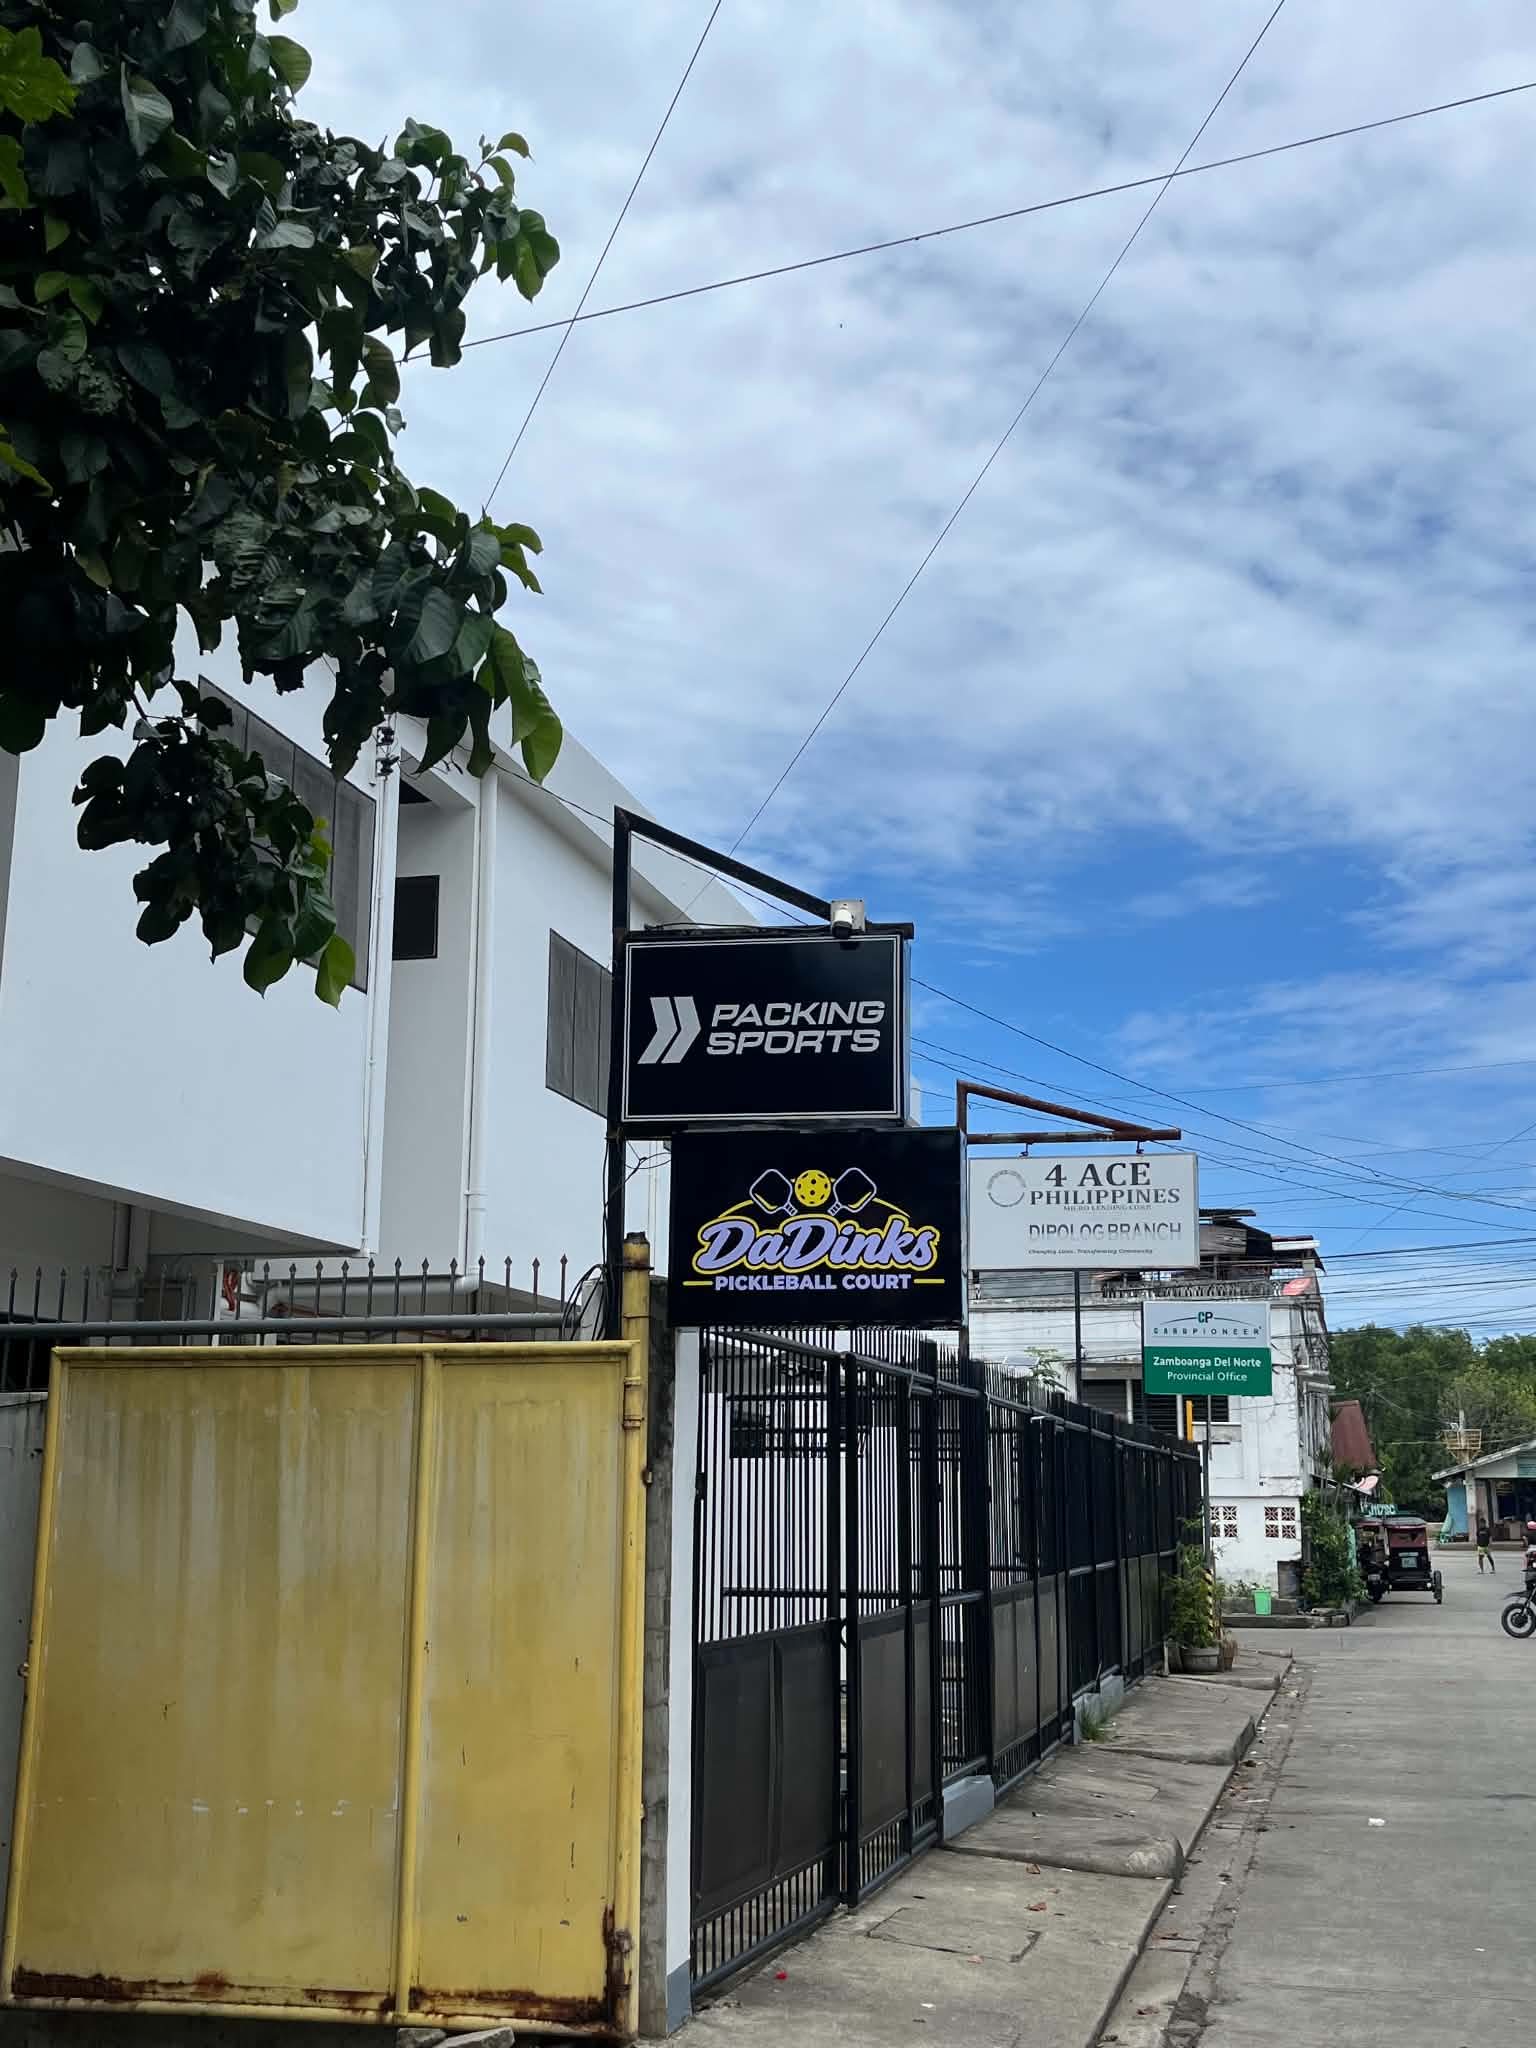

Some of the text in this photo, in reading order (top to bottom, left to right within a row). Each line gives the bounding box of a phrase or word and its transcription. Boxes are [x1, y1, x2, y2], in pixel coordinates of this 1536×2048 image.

[711, 1000, 886, 1027] PACKING
[706, 1028, 881, 1055] SPORTS
[1044, 1163, 1067, 1187] 4
[1077, 1161, 1151, 1187] ACE
[1029, 1187, 1181, 1206] PHILIPPINES
[1029, 1221, 1182, 1241] DIPOLOG BRANCH
[695, 1216, 938, 1272] DaDinks
[714, 1273, 912, 1291] PICKLEBALL COURT
[1197, 1311, 1214, 1323] CP
[1153, 1356, 1262, 1369] Zamboanga Del Norte
[1167, 1371, 1248, 1381] Provincial Office
